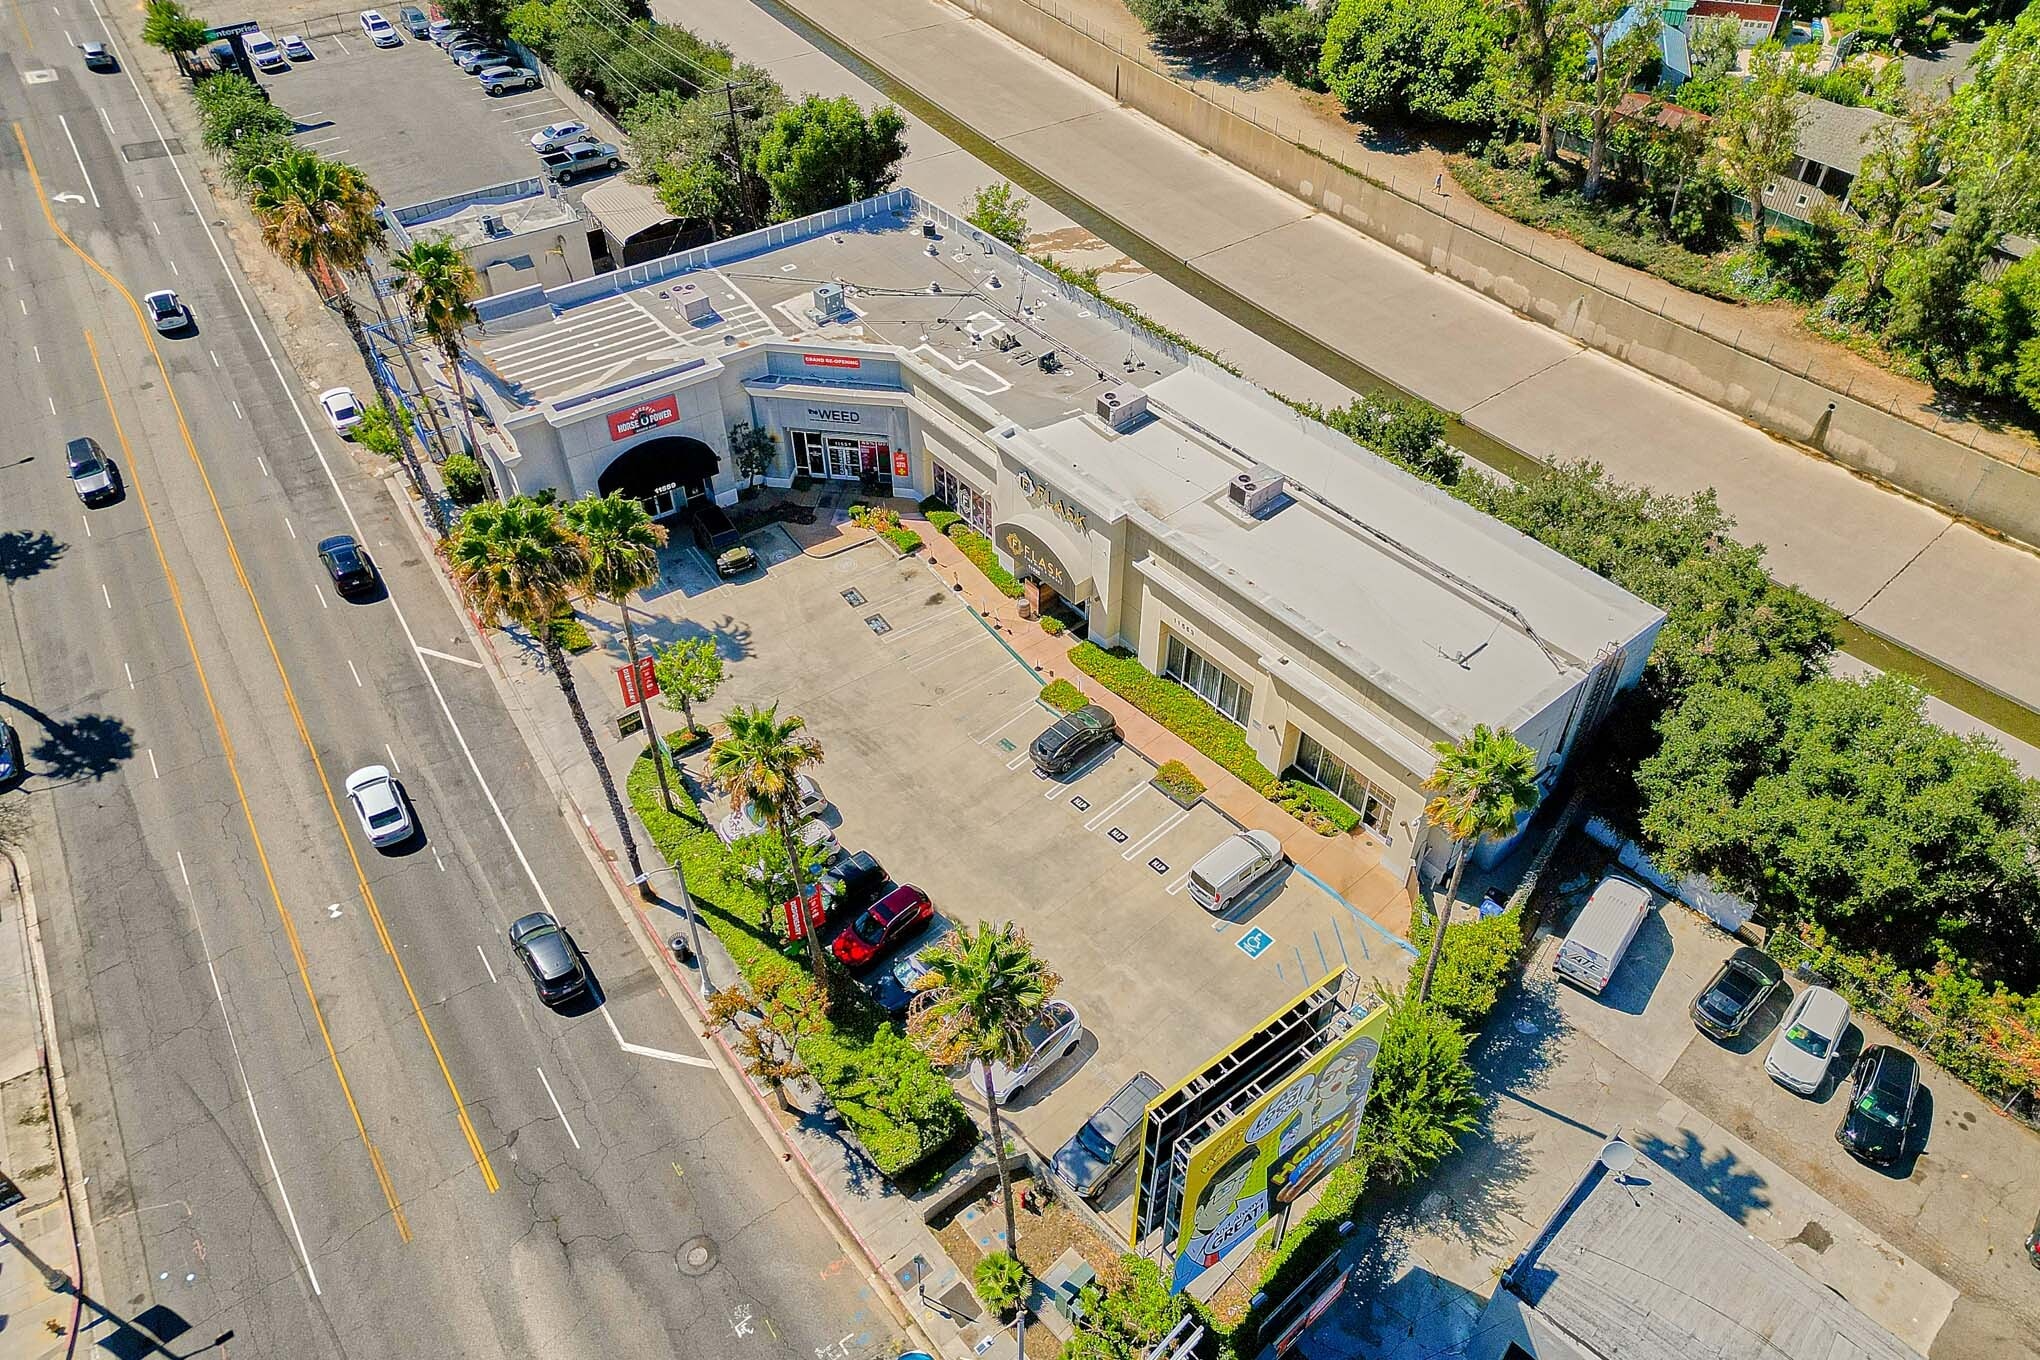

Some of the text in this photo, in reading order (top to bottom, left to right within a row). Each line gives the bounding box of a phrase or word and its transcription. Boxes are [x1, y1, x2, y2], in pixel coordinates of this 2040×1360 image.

[617, 419, 640, 434] HORSE
[649, 408, 673, 423] POWER
[818, 408, 860, 422] WEED
[1024, 544, 1063, 582] FLASK
[1271, 1112, 1350, 1186] HOFFY
[1212, 1203, 1264, 1249] GREAT!
